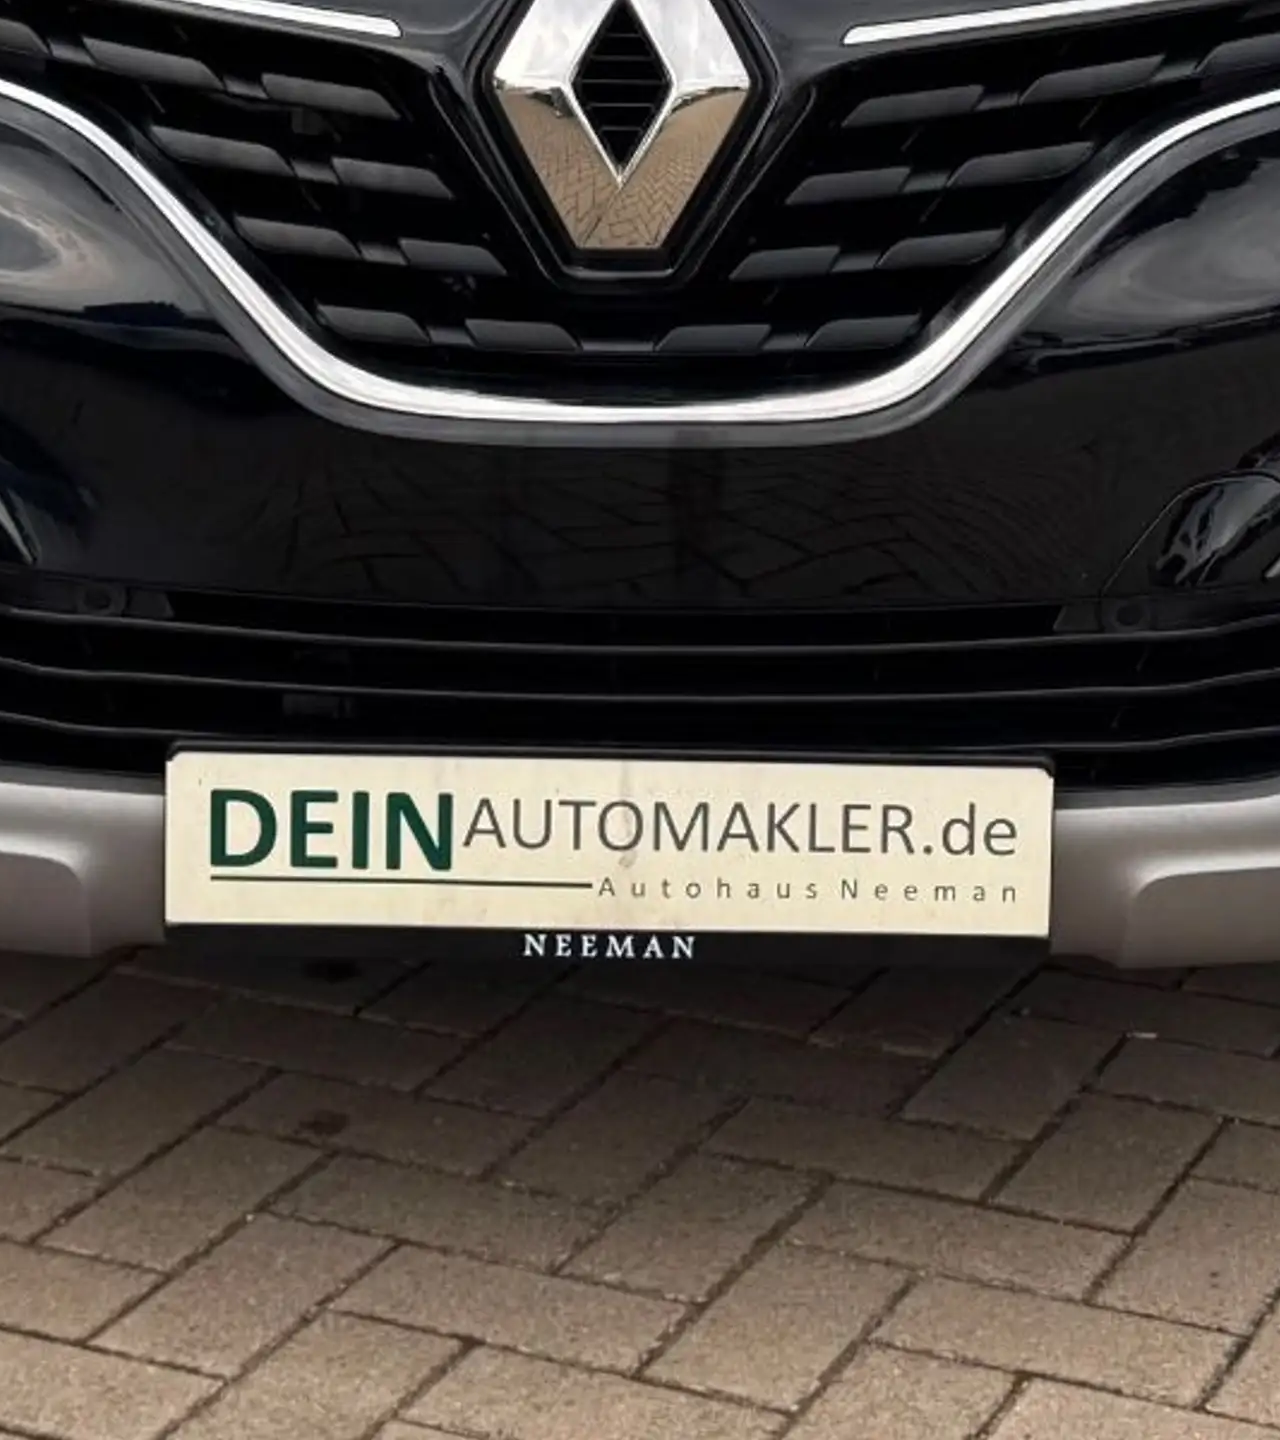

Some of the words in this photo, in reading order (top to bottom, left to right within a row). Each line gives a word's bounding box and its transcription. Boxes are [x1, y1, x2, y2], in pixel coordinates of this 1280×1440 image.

[598, 877, 818, 900] Autohaus
[841, 879, 1017, 902] Neeman
[523, 933, 695, 959] NEEMAN
